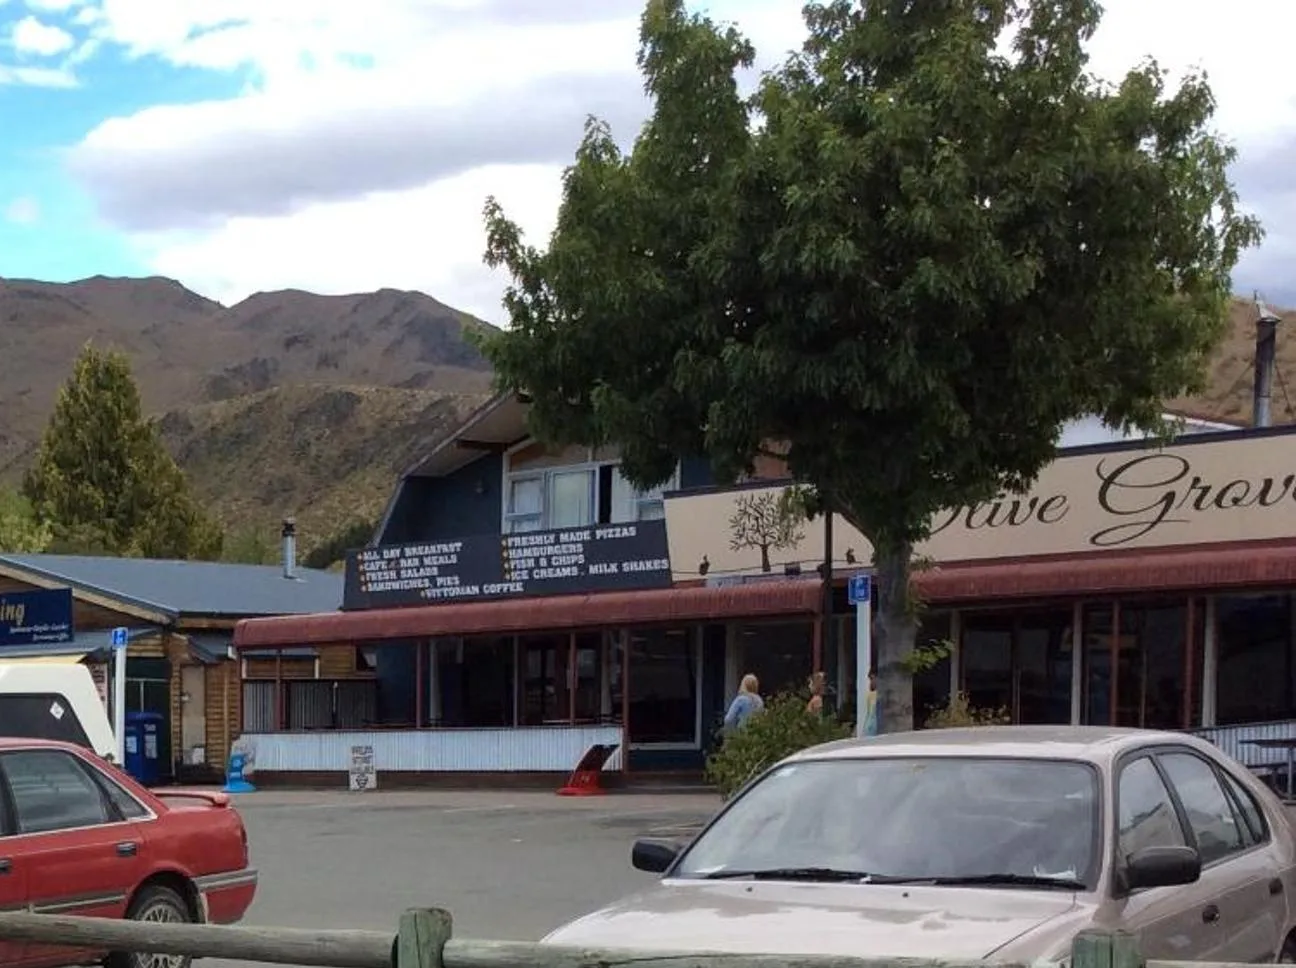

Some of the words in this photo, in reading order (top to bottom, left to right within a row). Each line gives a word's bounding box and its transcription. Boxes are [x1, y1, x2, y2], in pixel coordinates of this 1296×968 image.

[930, 494, 1070, 535] ive
[1090, 453, 1296, 546] Grov
[507, 533, 555, 547] FRESHLY
[559, 529, 591, 543] MADE
[595, 526, 637, 540] PIZZAS
[383, 549, 402, 559] DAY
[404, 542, 463, 557] BREAKFAST
[508, 543, 584, 559] HAMBURGERS
[400, 557, 420, 568] BAR
[423, 554, 457, 566] MEALS
[510, 558, 535, 570] FISH
[551, 554, 585, 566] CHIPS
[366, 570, 397, 581] FRESH
[400, 567, 439, 578] SALADS
[511, 570, 529, 581] ICE
[589, 562, 618, 575] MILK
[622, 559, 669, 572] SHAKES
[436, 576, 460, 587] PIES
[483, 582, 525, 594] COFFEE
